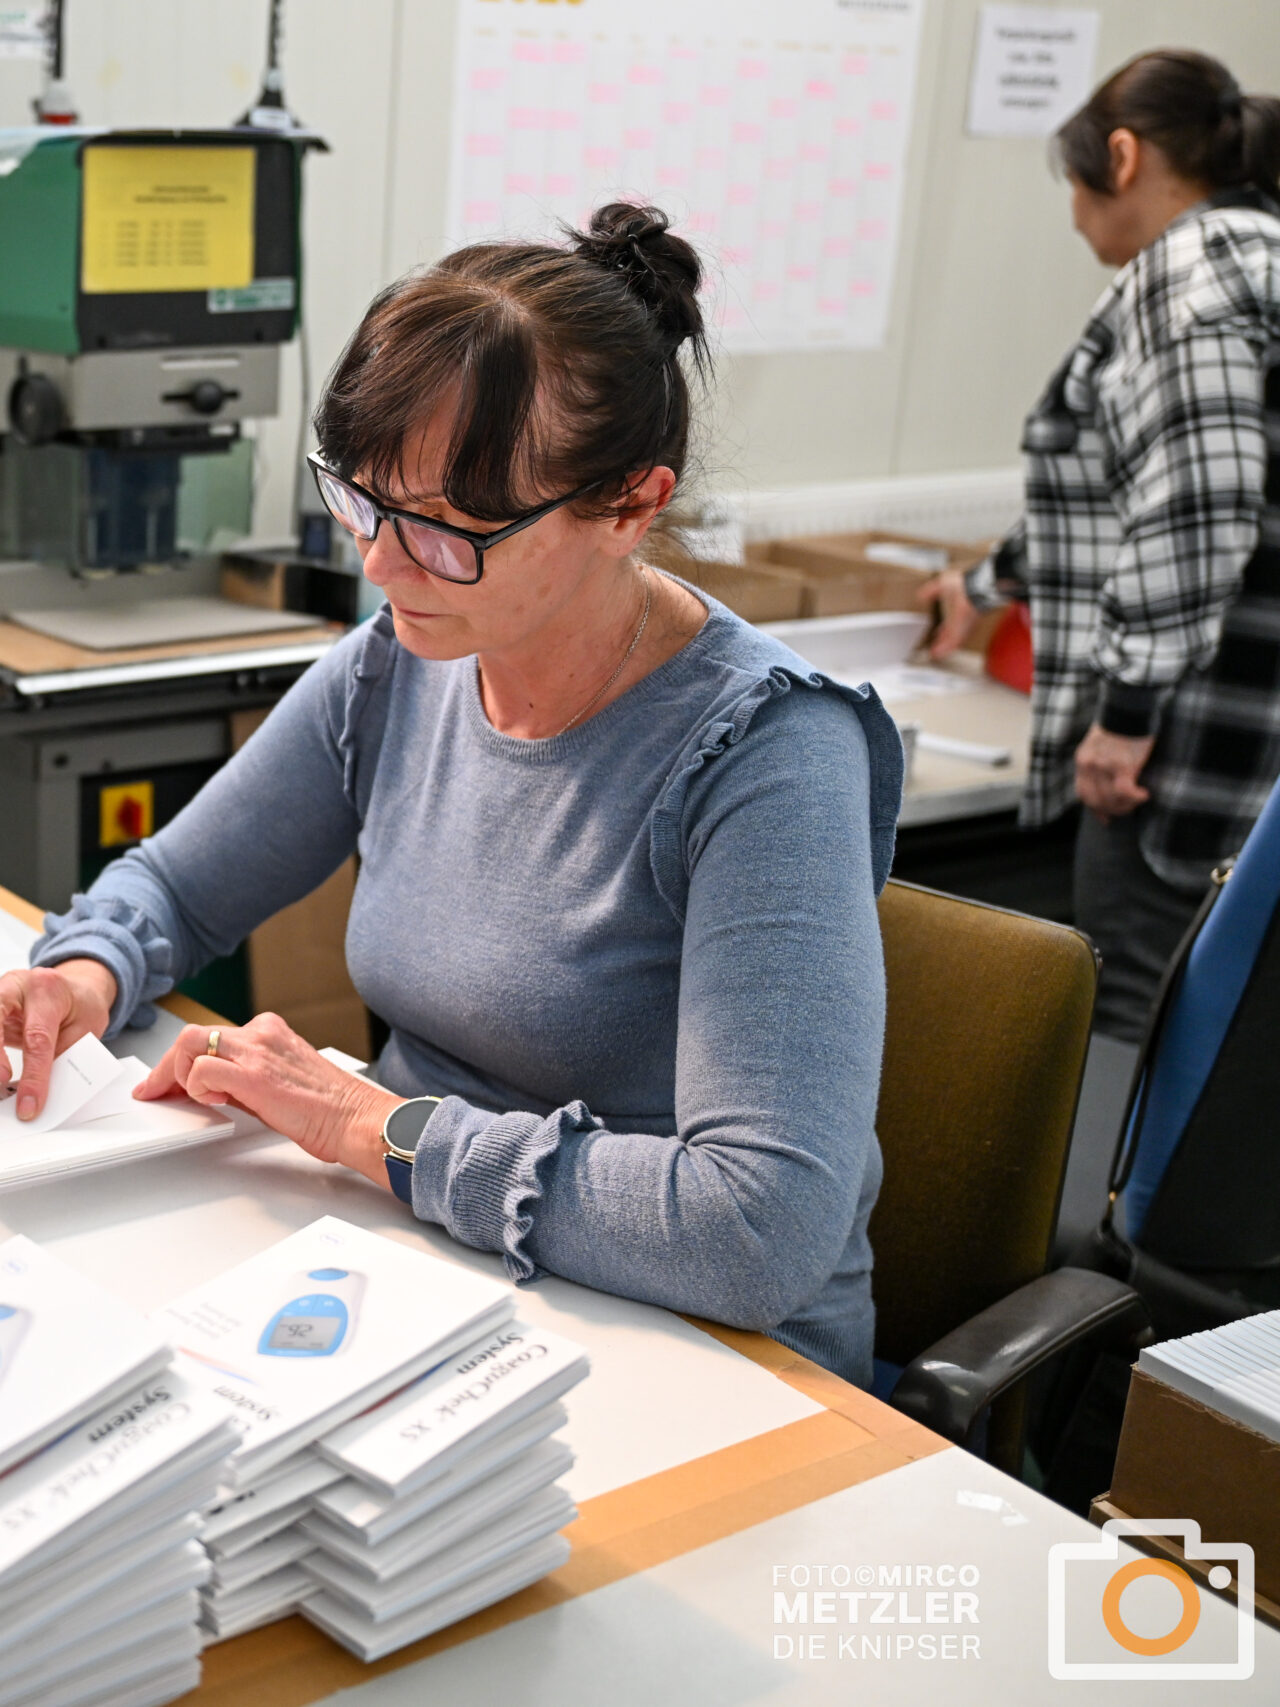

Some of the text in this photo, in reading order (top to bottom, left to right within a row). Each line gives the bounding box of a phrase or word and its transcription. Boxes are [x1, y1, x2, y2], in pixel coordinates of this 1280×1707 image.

[457, 1331, 523, 1376] System
[86, 1384, 172, 1445] System
[213, 1385, 281, 1422] System
[400, 1419, 432, 1441] XS
